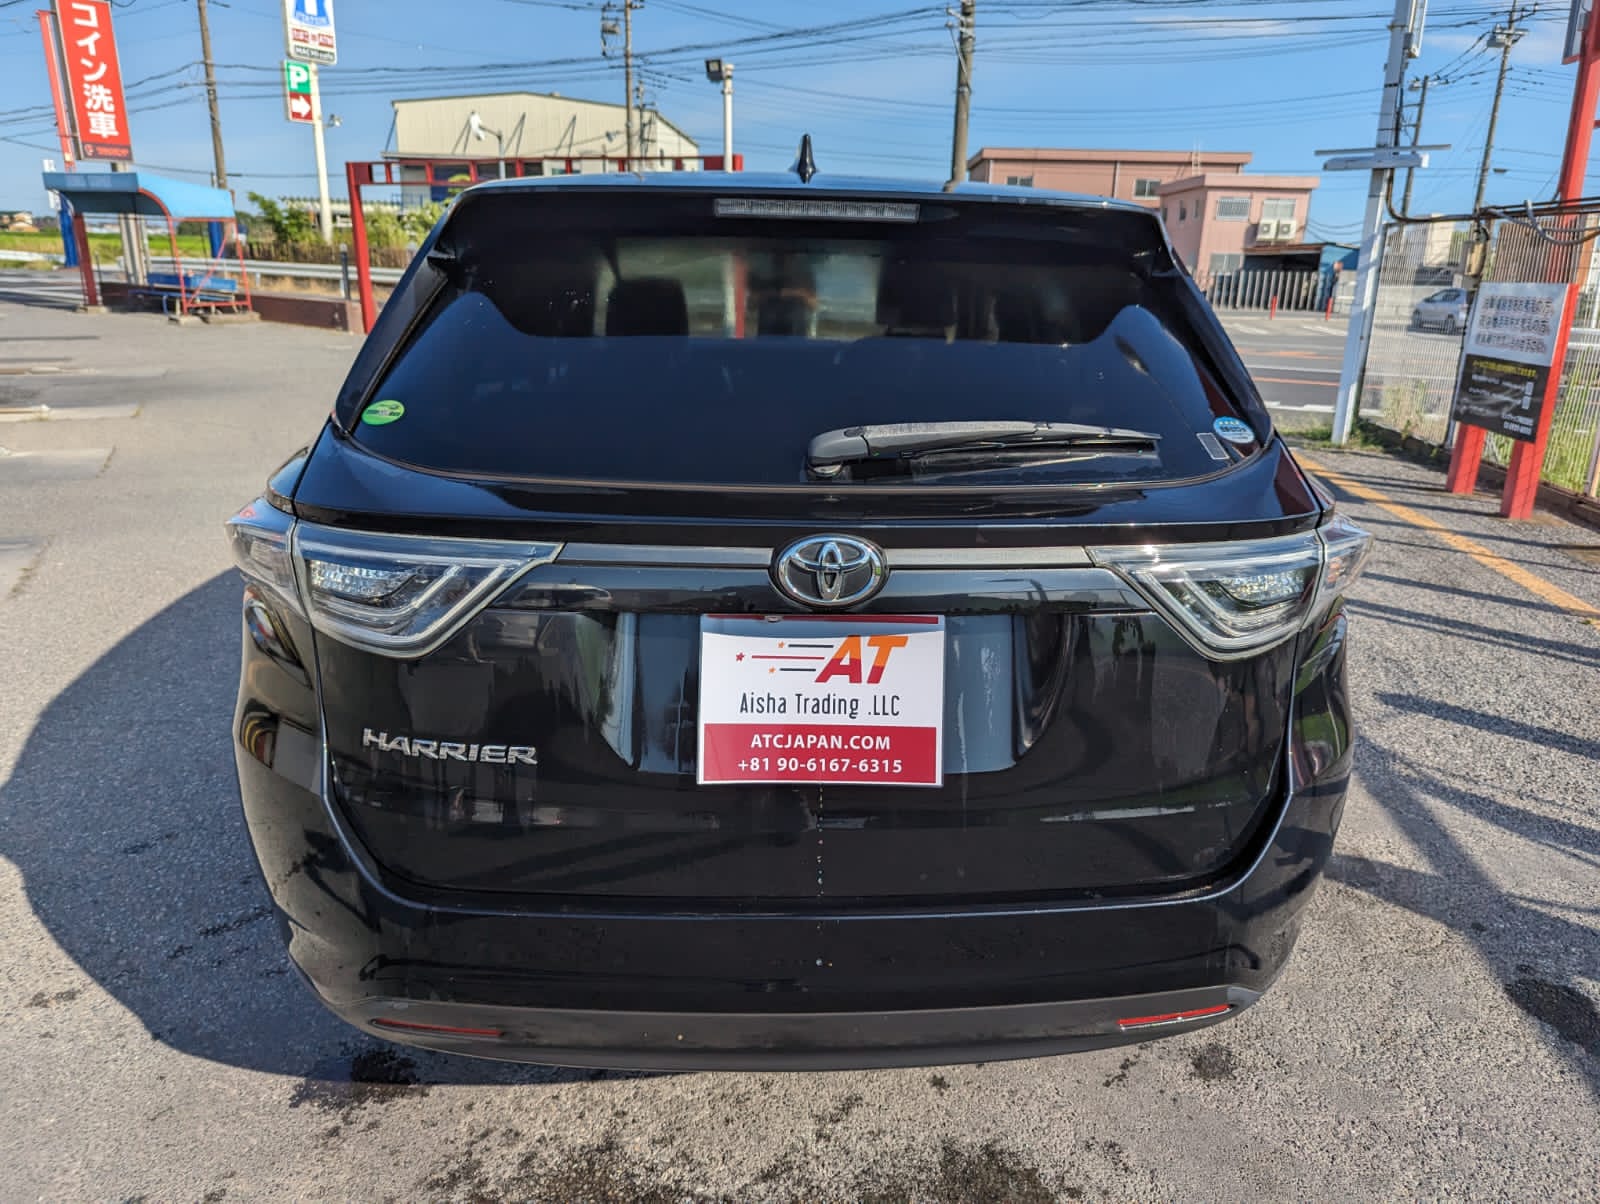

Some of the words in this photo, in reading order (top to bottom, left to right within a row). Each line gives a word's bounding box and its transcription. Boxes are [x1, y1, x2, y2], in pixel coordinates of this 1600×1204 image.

[71, 2, 120, 139] コイン洗車
[287, 64, 308, 90] P
[814, 634, 909, 684] AT
[739, 692, 787, 714] Aisha
[795, 693, 860, 719] Trading
[868, 694, 901, 717] .LLC
[362, 727, 538, 765] HARRIER
[750, 733, 891, 751] ATCJAPAN.COM
[738, 757, 770, 772] +81
[777, 757, 903, 774] 90-6167-6315
